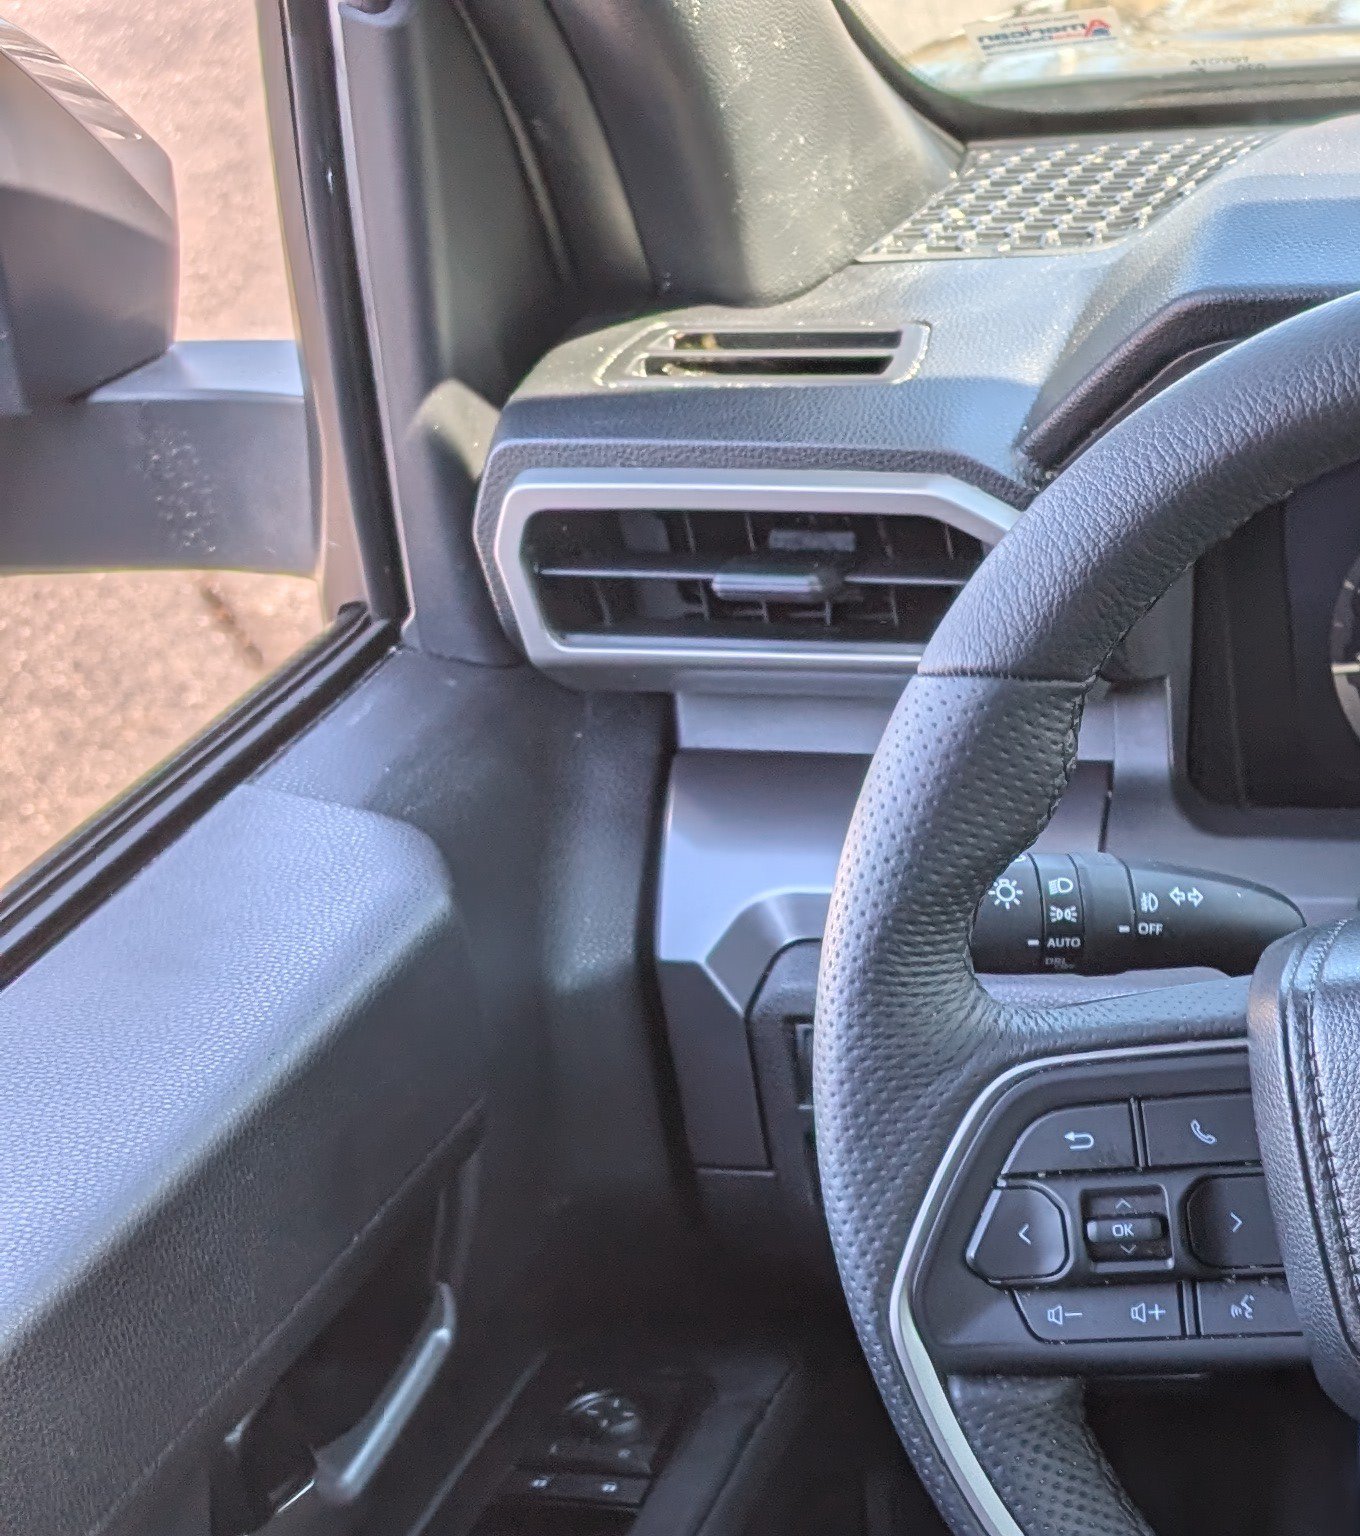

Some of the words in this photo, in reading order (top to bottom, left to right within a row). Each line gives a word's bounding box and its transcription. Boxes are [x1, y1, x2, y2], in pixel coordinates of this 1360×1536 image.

[1139, 923, 1163, 936] OFF
[1046, 937, 1081, 949] AUTO
[1112, 1224, 1134, 1237] OK
